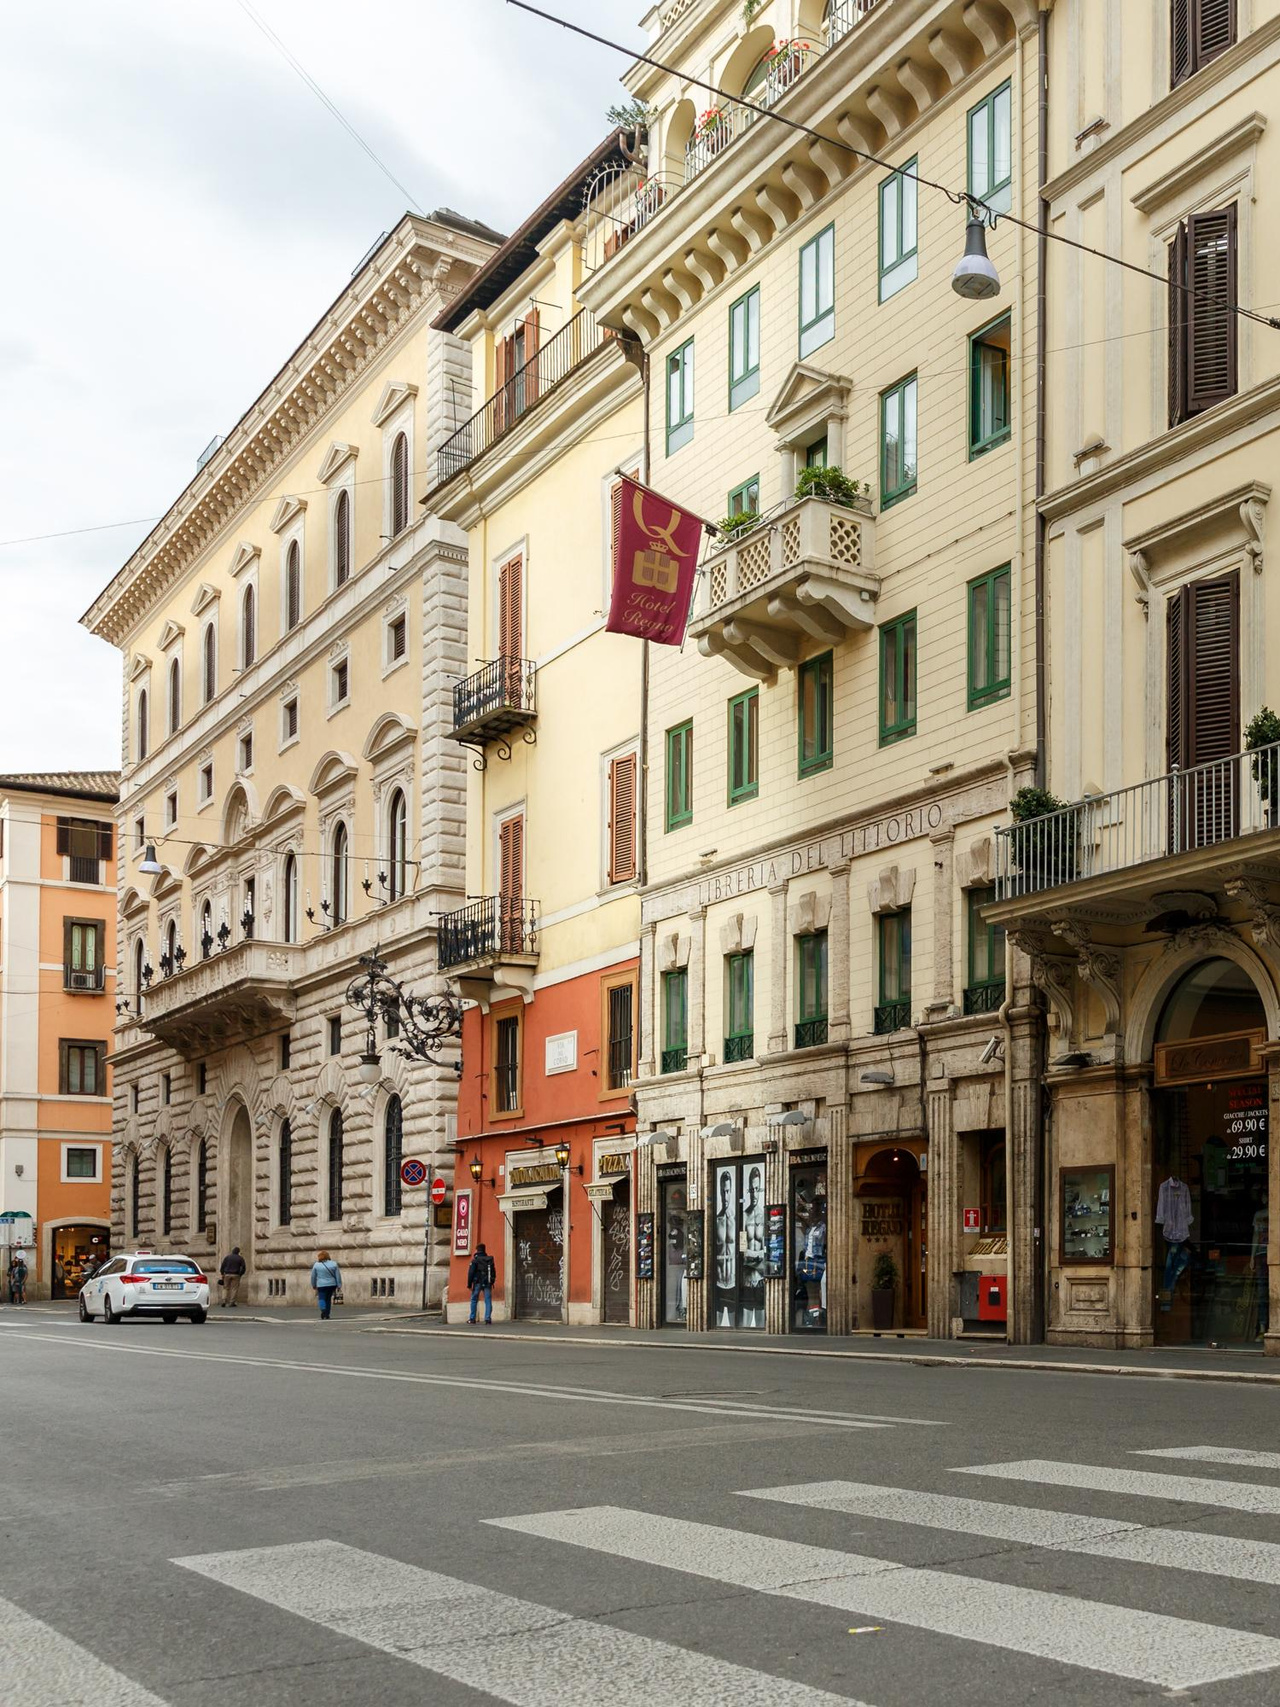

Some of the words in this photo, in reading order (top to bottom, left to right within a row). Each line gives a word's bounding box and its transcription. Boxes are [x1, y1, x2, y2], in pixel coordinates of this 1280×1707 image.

[627, 592, 676, 614] Hotel
[622, 608, 674, 637] Regno
[698, 860, 777, 906] LIBRERIA
[791, 843, 825, 875] DEL
[840, 804, 942, 859] LITTORIO
[1229, 1098, 1263, 1110] SEASON
[1223, 1112, 1245, 1120] GIACCHE
[1248, 1109, 1268, 1118] JACKETS
[1231, 1119, 1257, 1133] 69.90
[1259, 1118, 1265, 1131] €
[789, 1152, 827, 1164] BARONE
[1232, 1145, 1257, 1159] 29.90
[1259, 1144, 1265, 1157] €
[862, 1203, 900, 1218] HOTEL
[861, 1219, 902, 1236] REGNO
